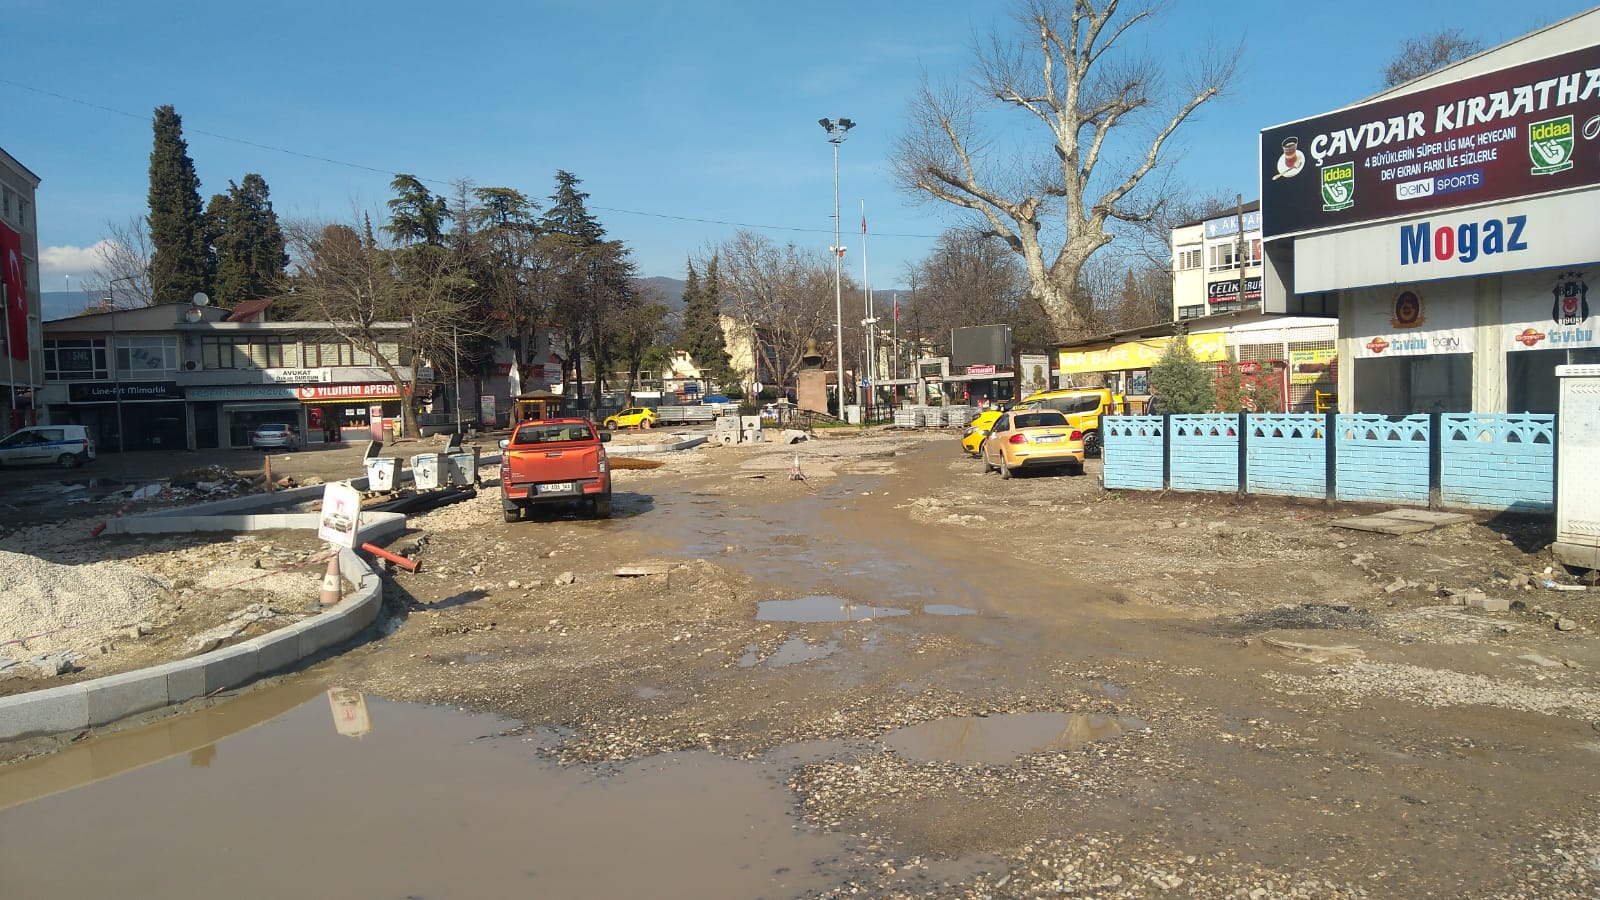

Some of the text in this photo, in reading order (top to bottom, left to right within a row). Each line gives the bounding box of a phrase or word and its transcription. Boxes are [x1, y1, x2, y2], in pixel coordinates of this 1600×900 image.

[1311, 110, 1426, 167] ÇAVDAR
[1532, 122, 1570, 140] iddaa
[1364, 126, 1517, 168] 4 BÜYÜKLERİN SÜPER LİG MAÇ HEYECANI
[1381, 148, 1497, 181] DEV EKRAN FARKI İLE SİZLERLE
[1323, 167, 1352, 182] iddaa
[1437, 173, 1480, 190] SPORTS
[1222, 217, 1236, 230] AK
[1400, 215, 1528, 265] Mogaz
[318, 385, 361, 396] YILDIRIM
